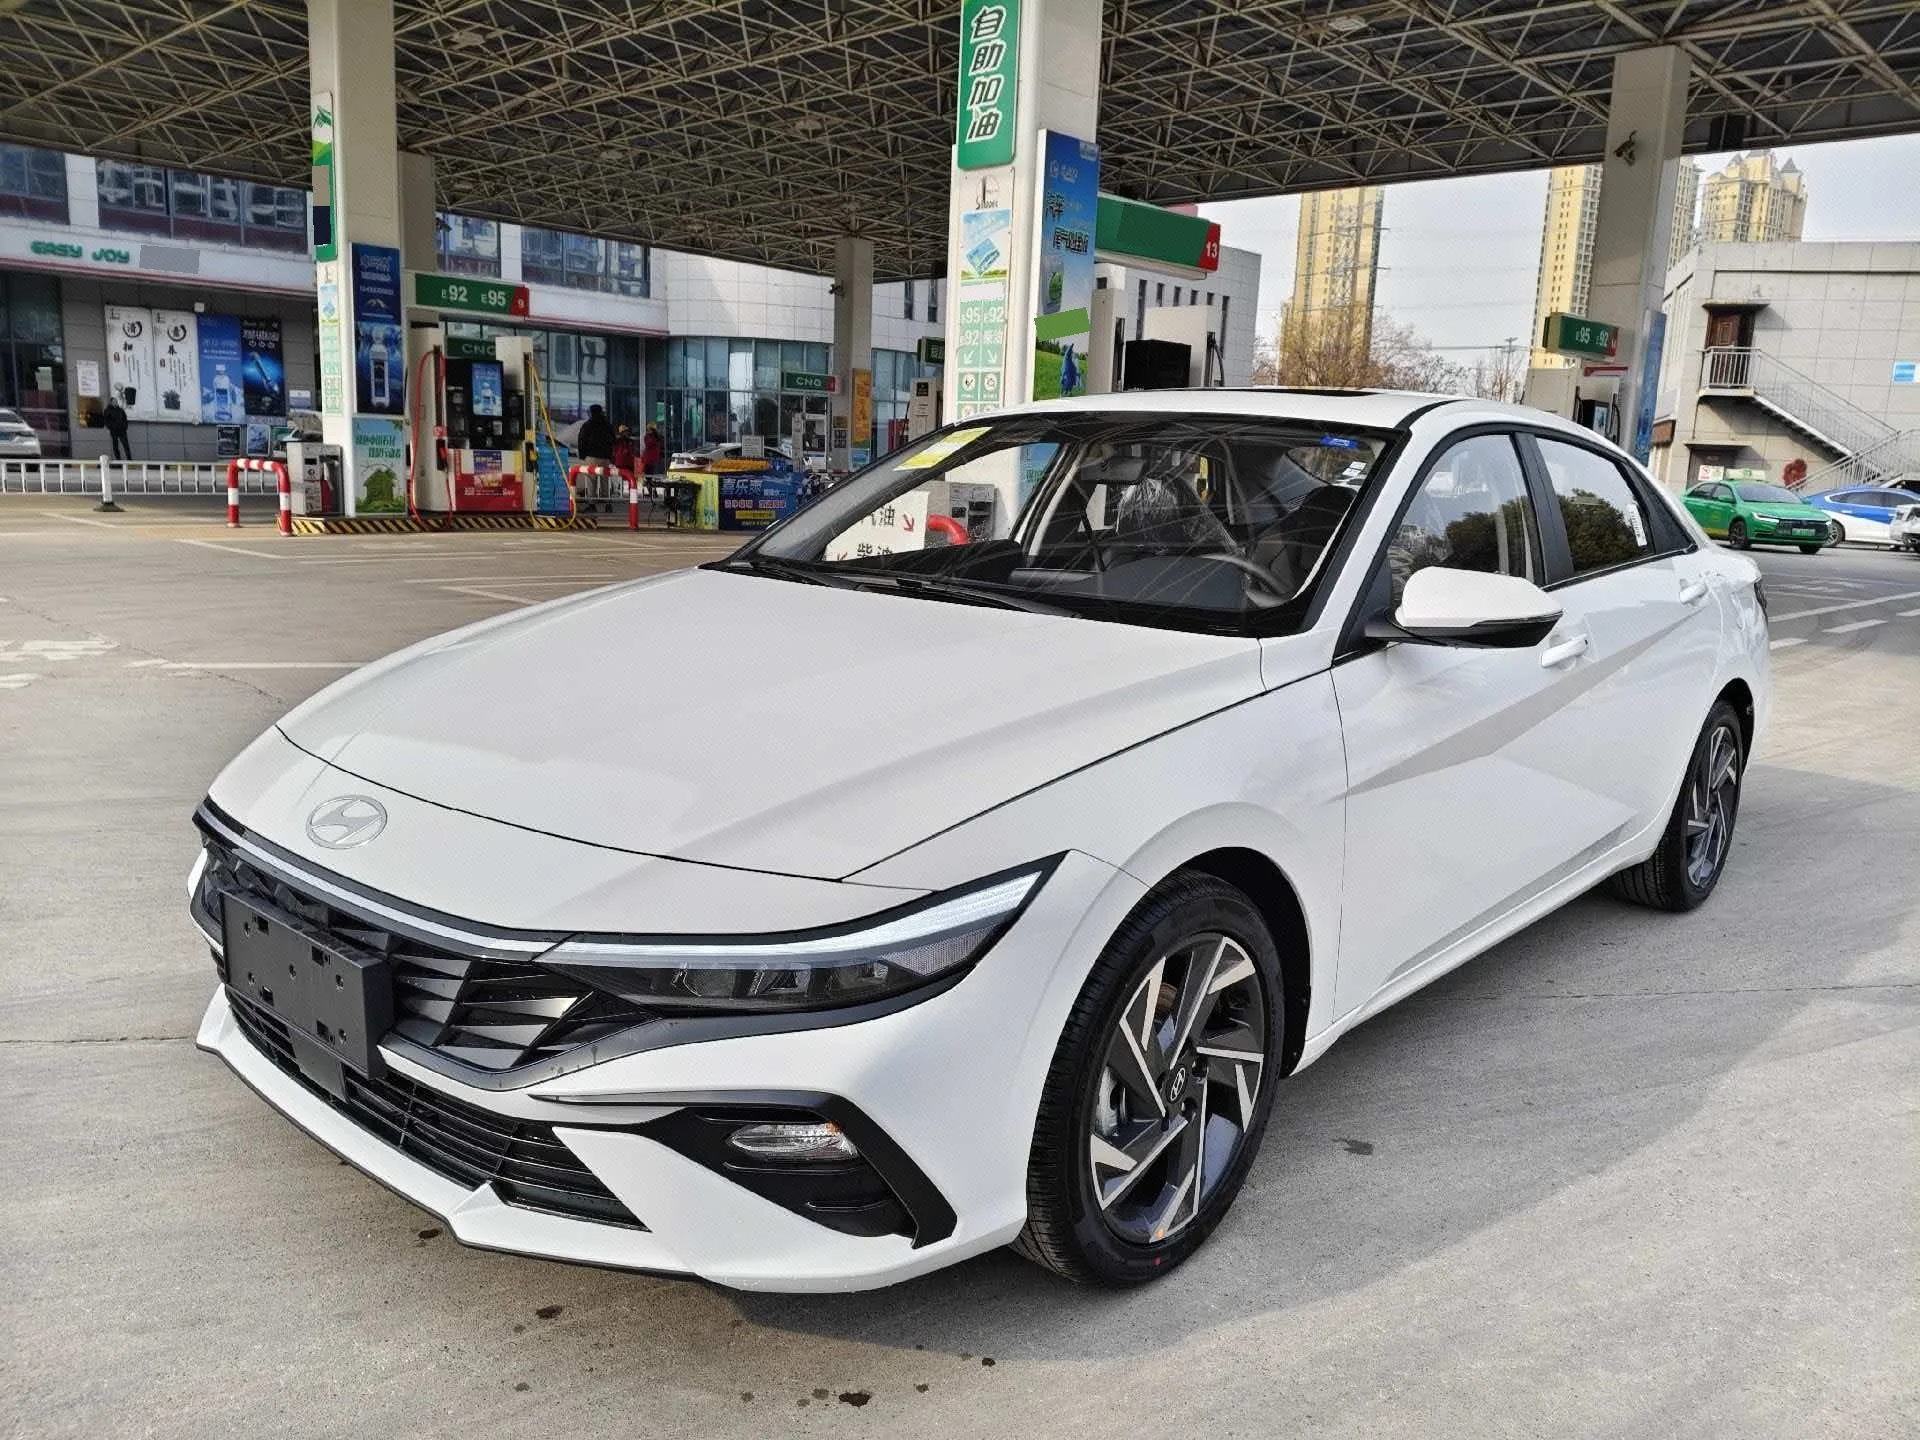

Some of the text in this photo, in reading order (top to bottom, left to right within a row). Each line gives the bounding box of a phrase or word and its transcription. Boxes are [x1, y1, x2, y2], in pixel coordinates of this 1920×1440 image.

[966, 5, 1006, 142] 自助加油
[31, 240, 130, 264] EASY JOY
[1206, 241, 1218, 258] 13
